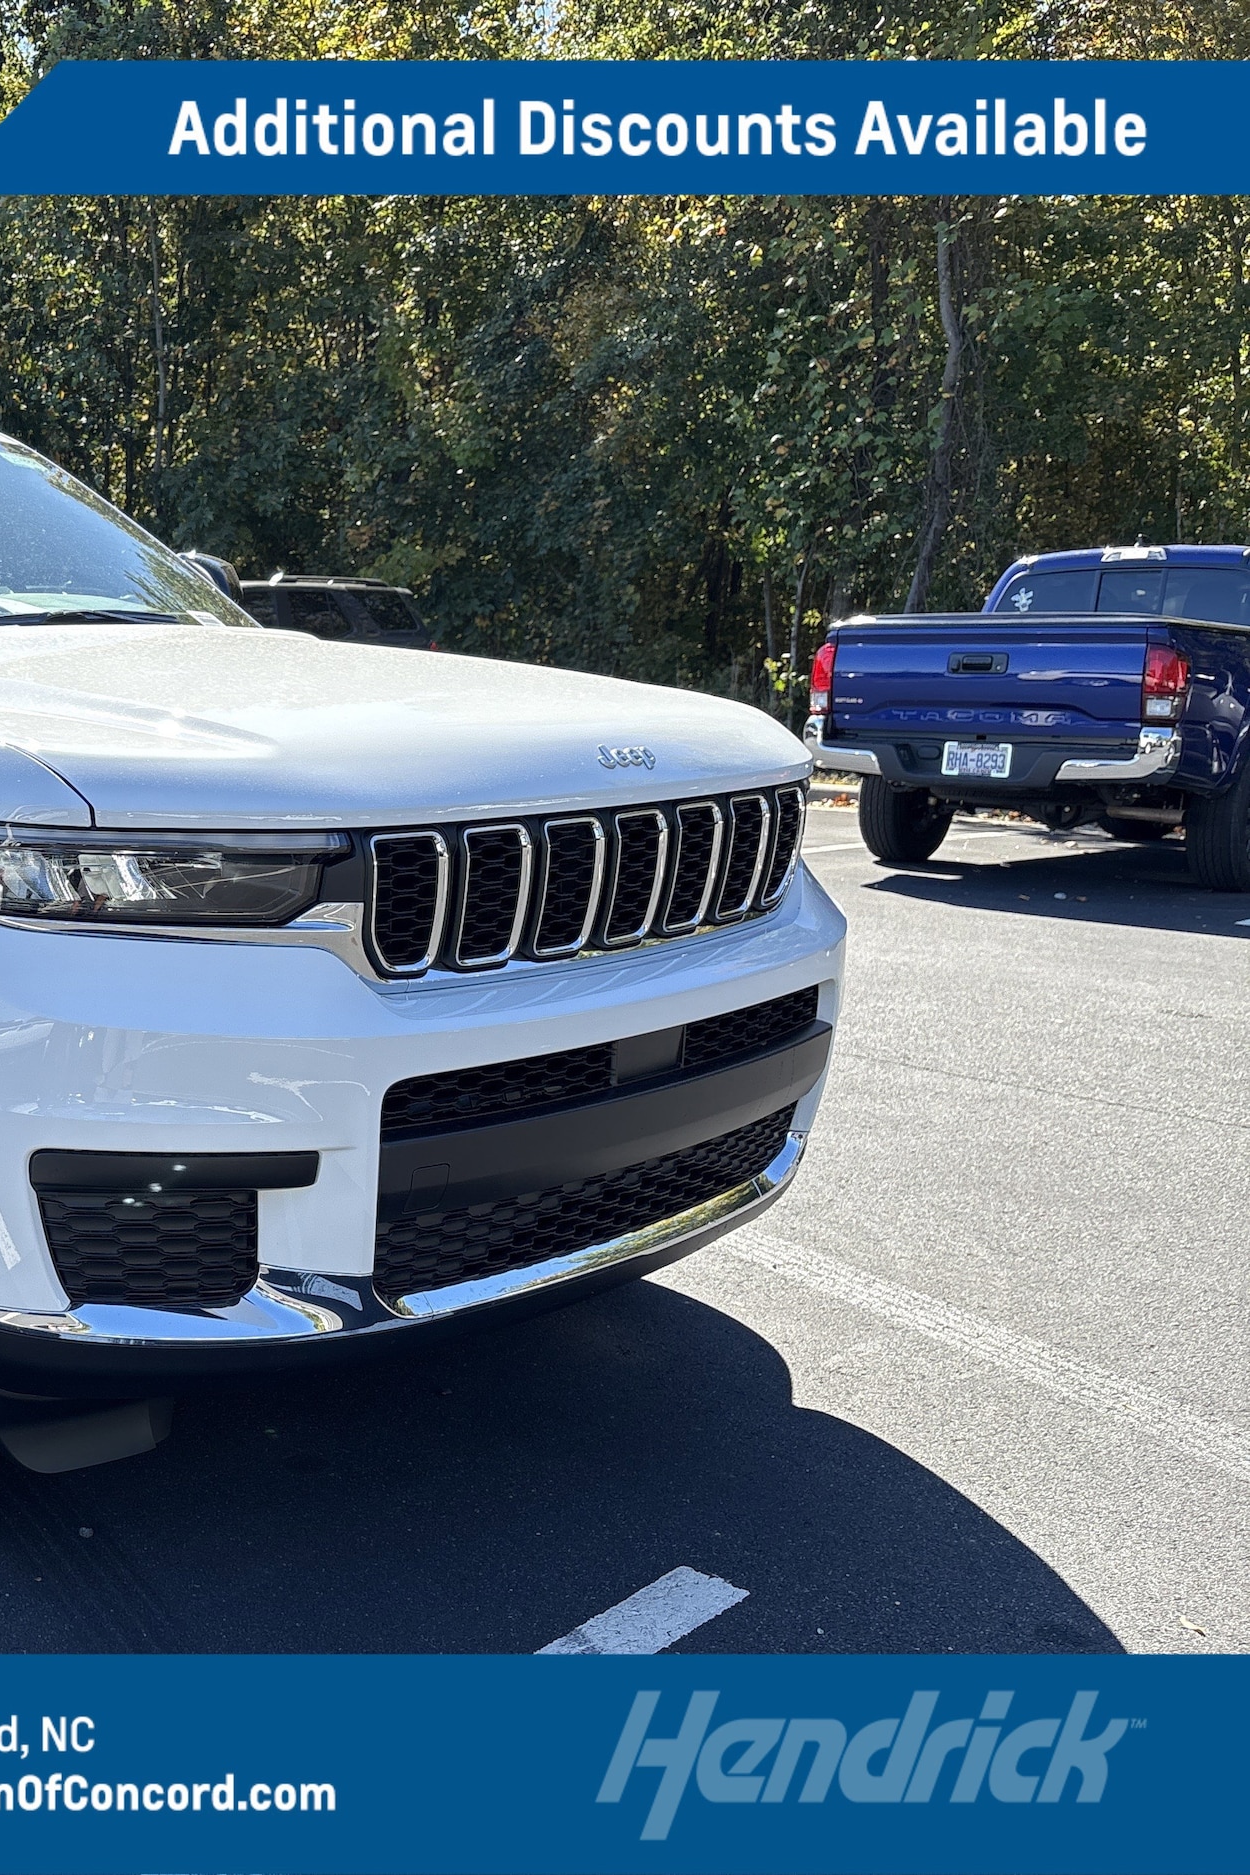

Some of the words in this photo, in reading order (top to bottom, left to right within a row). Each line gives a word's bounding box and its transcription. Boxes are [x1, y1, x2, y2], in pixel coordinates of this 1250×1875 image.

[892, 708, 1071, 726] TACOMA
[596, 743, 657, 771] Jeep
[947, 751, 1006, 770] RHA-8293
